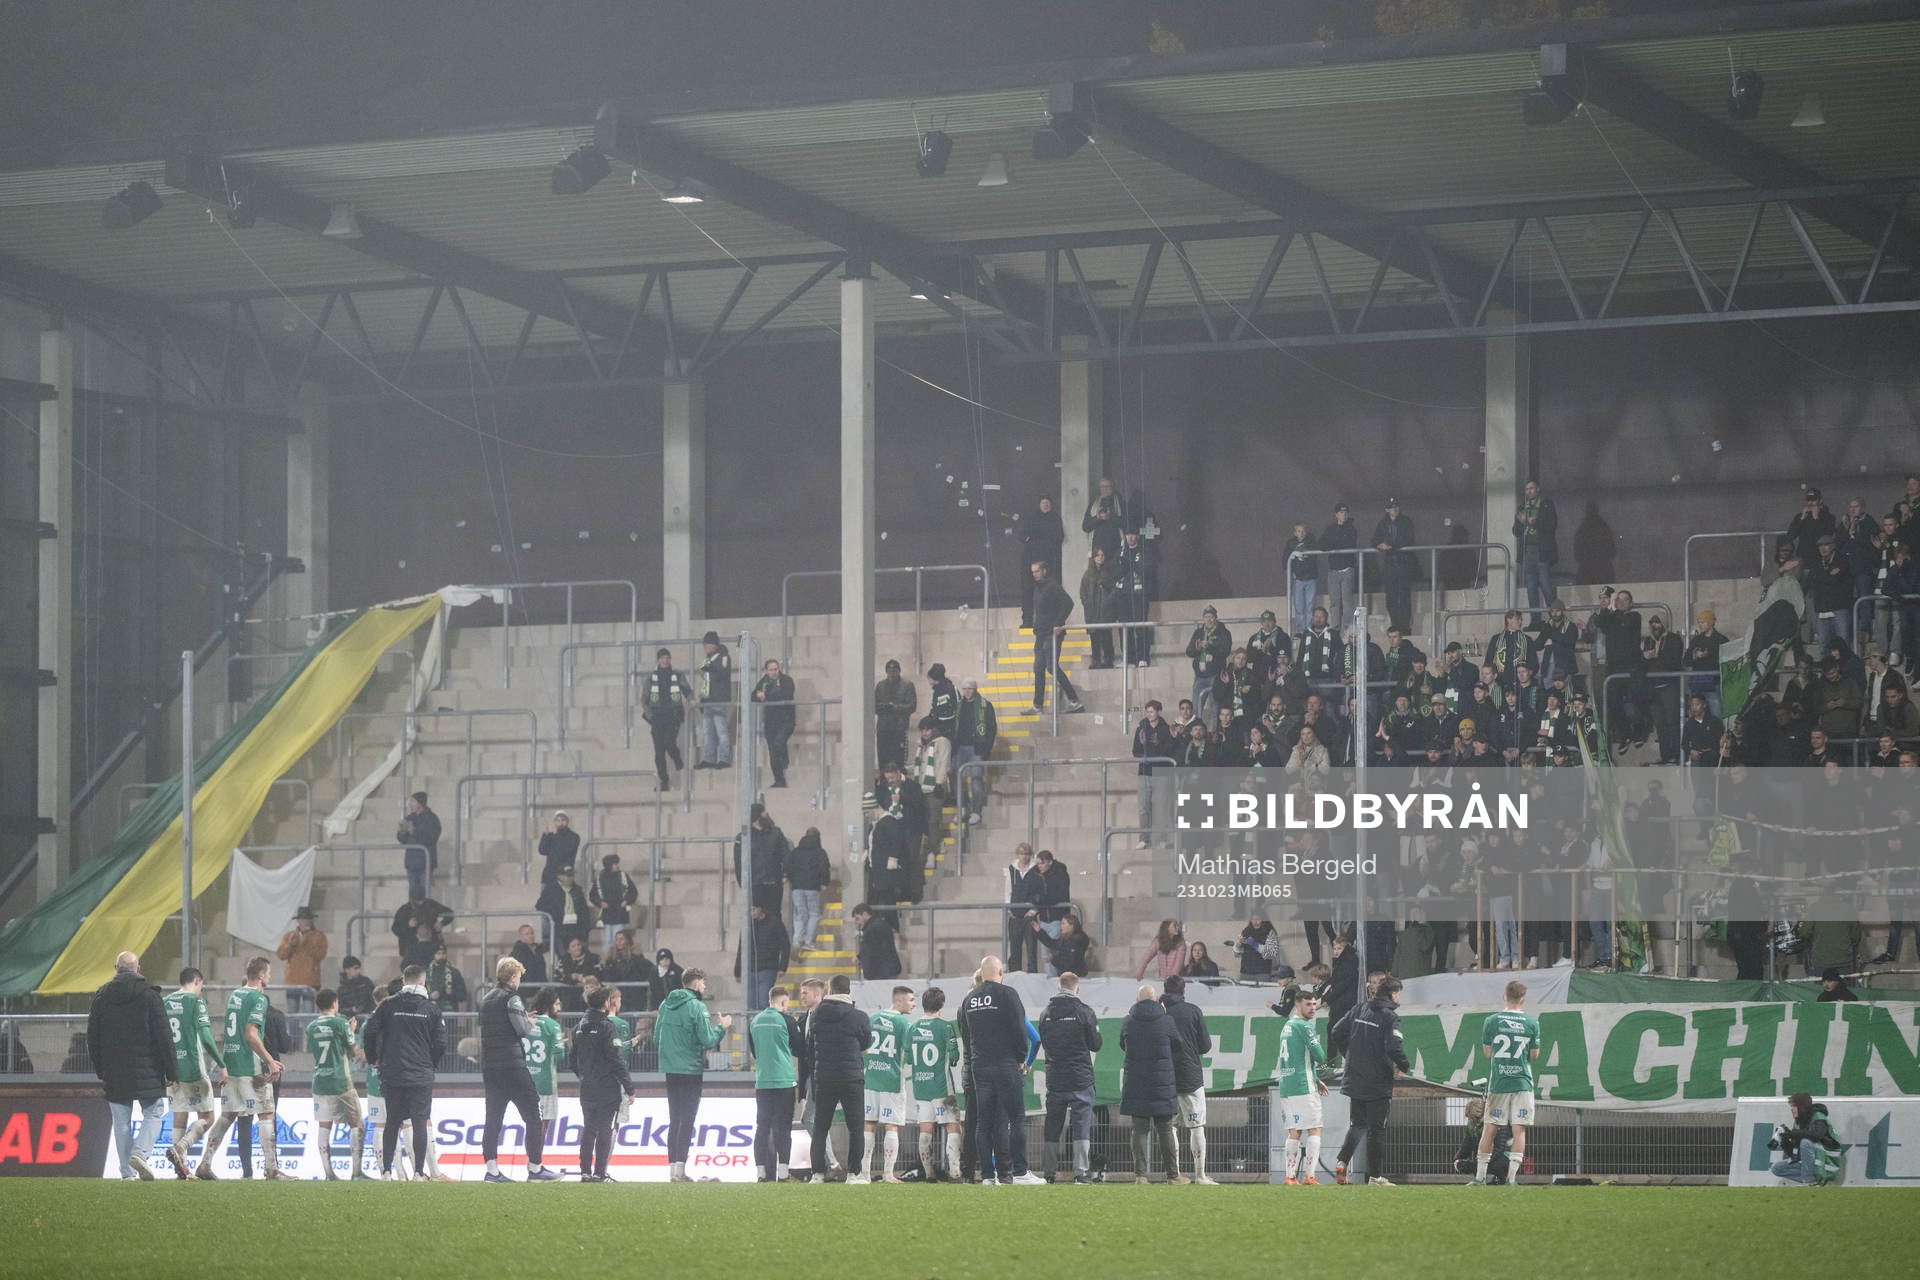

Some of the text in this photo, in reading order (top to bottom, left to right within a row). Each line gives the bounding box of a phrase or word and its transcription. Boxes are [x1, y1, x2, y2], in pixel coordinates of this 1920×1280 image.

[970, 995, 992, 1008] SLO
[318, 1041, 331, 1064] 7
[867, 1030, 897, 1058] 24
[911, 1043, 940, 1067] 10
[1493, 1033, 1531, 1059] 27
[694, 1151, 749, 1167] RÖR
